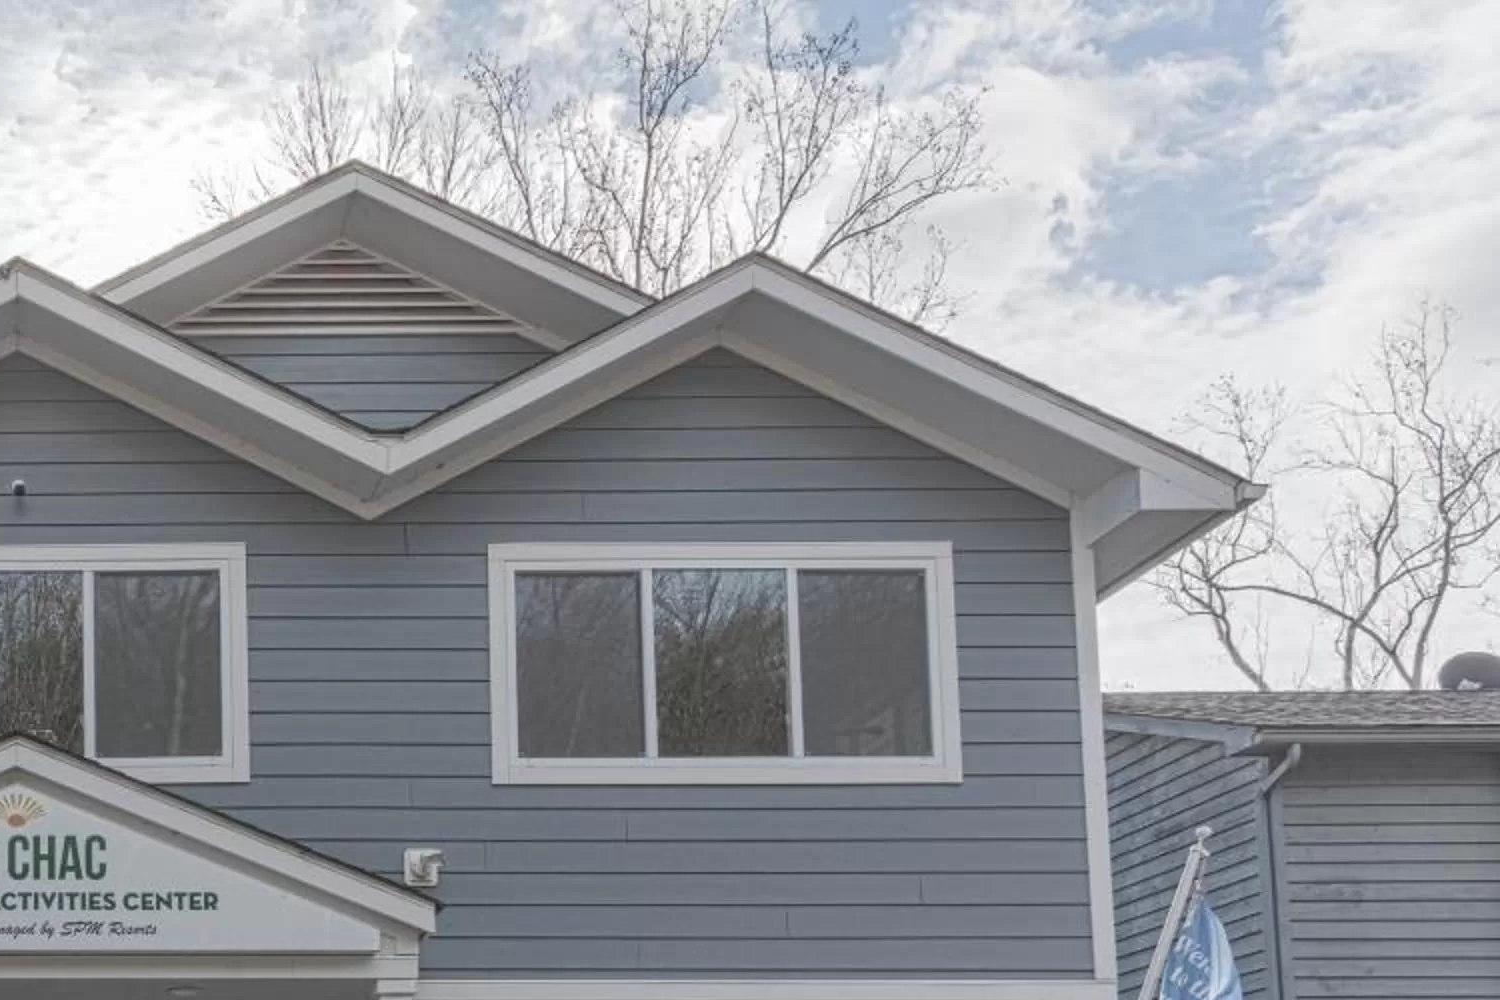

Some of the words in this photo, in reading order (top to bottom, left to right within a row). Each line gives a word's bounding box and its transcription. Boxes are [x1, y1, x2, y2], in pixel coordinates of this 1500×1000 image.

[7, 834, 107, 881] CHAC
[123, 890, 219, 912] CENTER
[39, 920, 56, 938] by
[59, 920, 104, 937] SPM
[107, 920, 158, 937] Resorts
